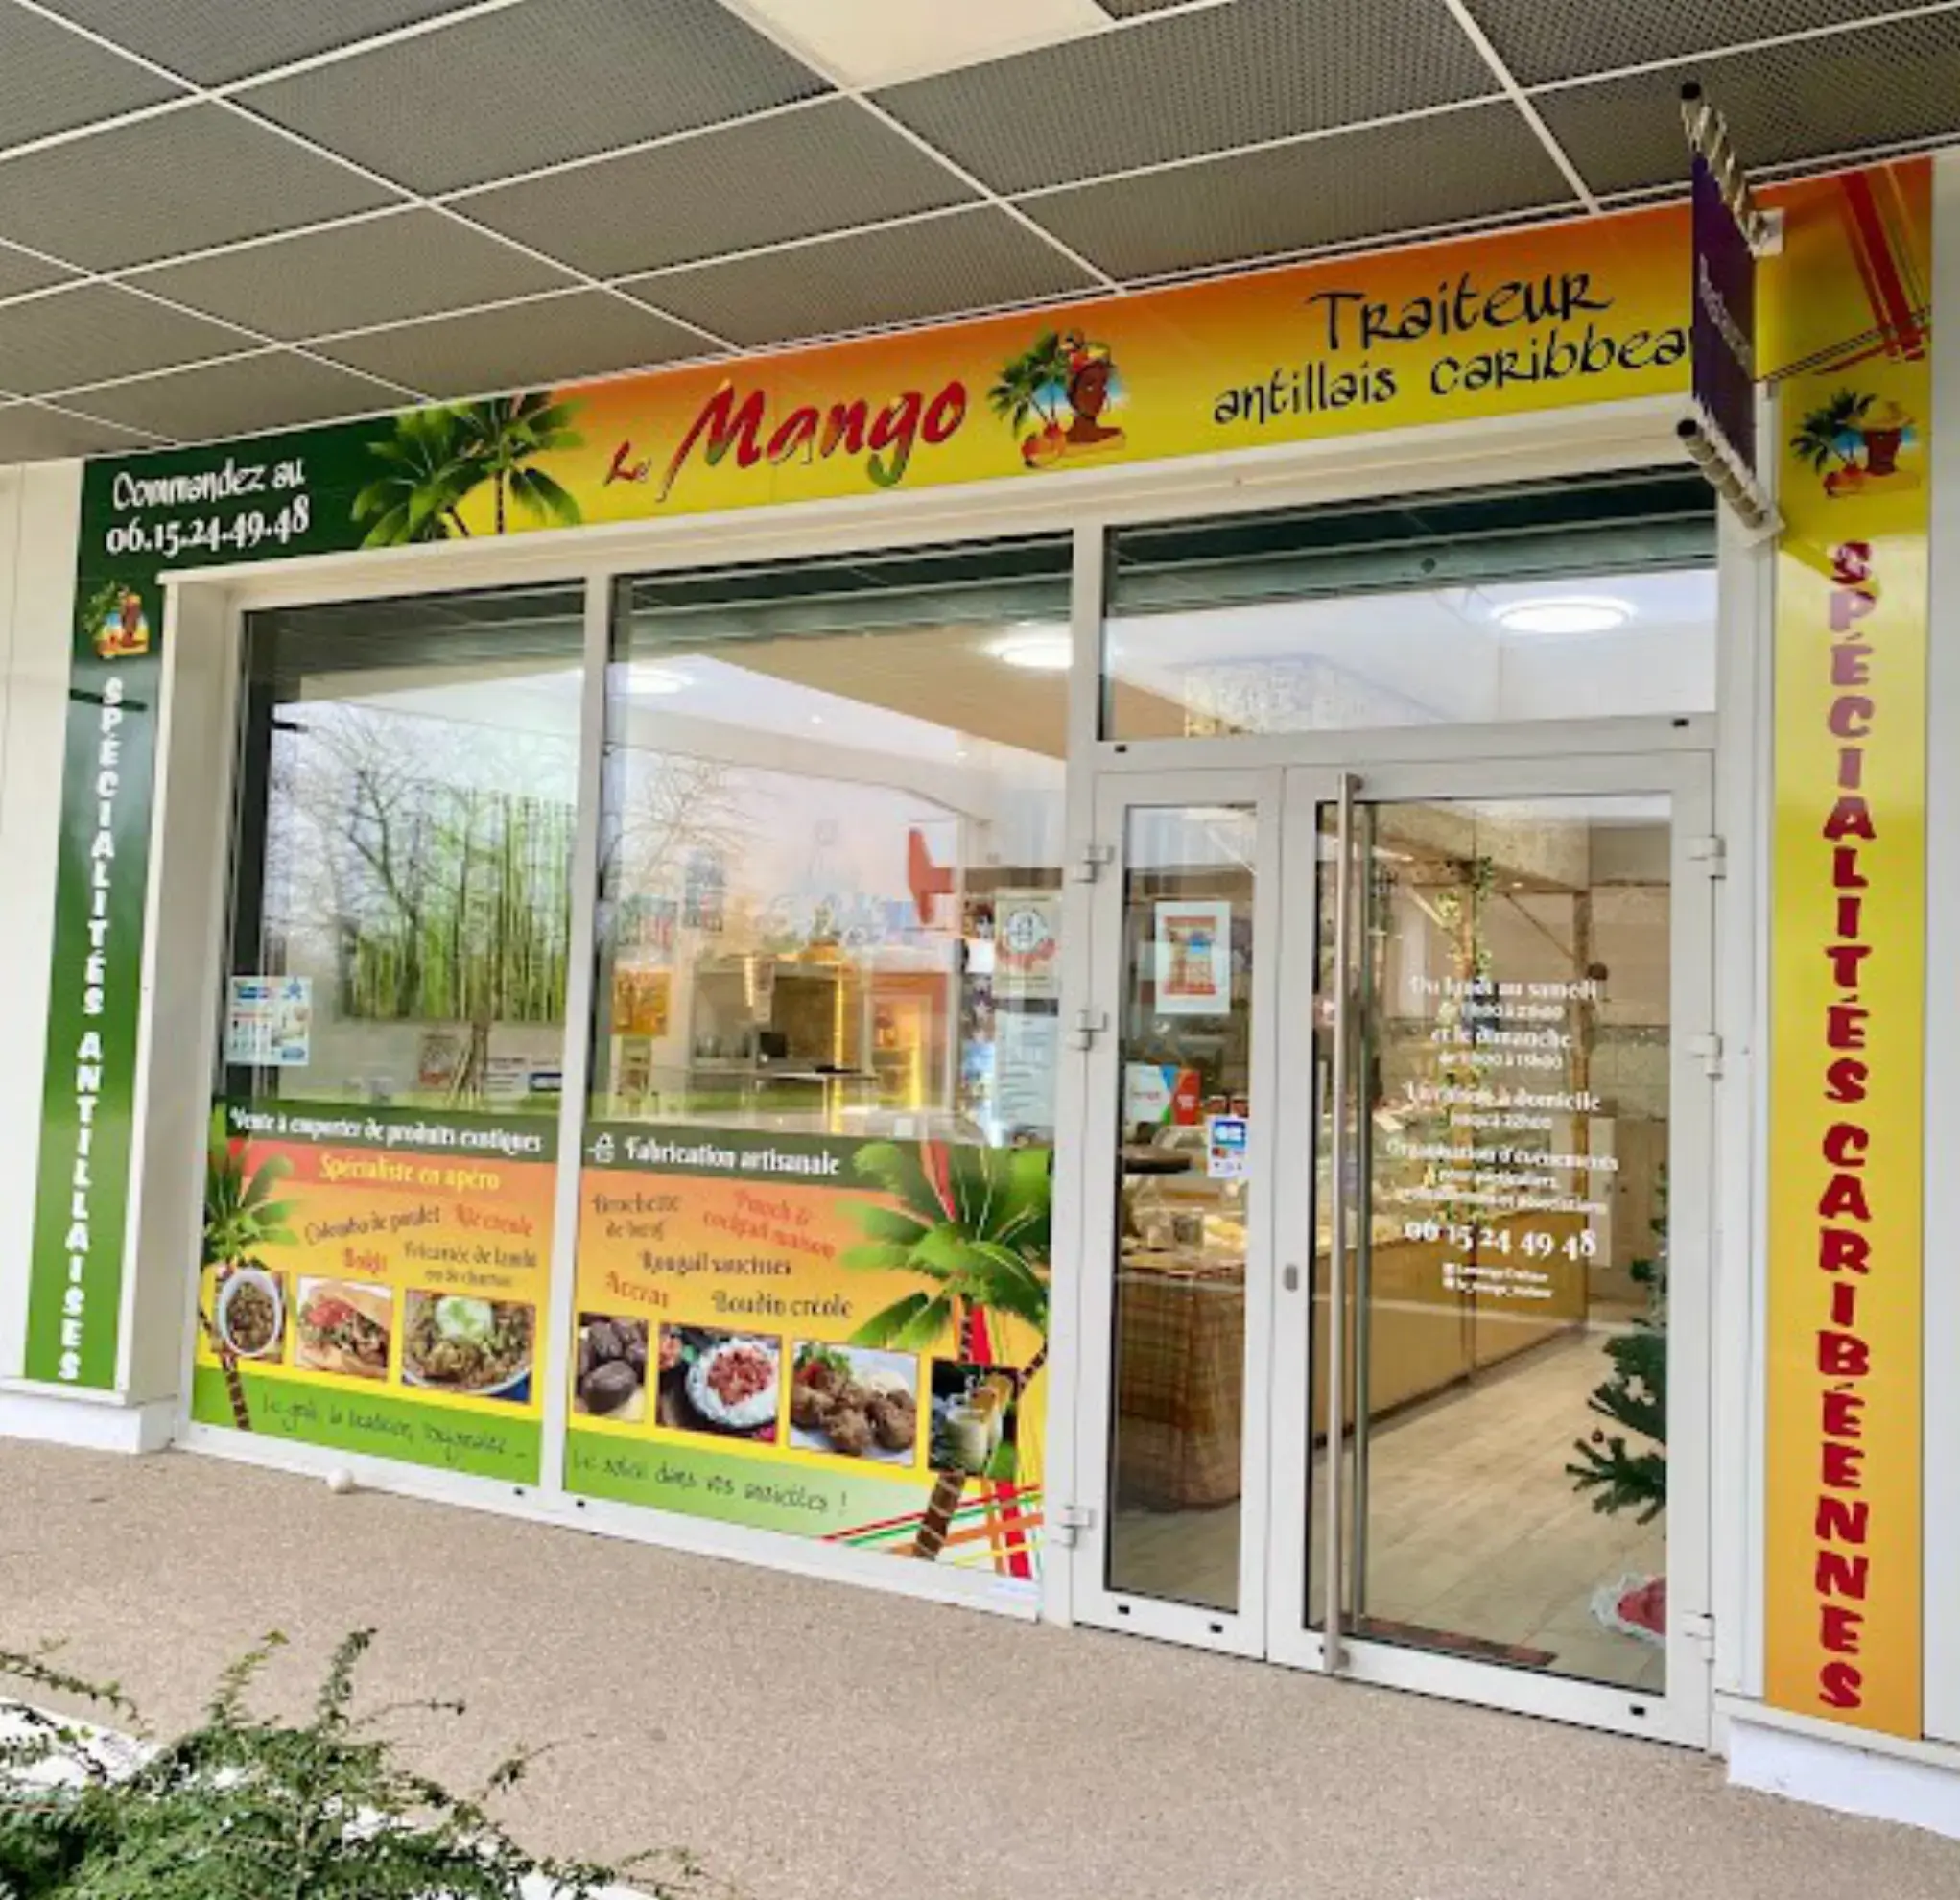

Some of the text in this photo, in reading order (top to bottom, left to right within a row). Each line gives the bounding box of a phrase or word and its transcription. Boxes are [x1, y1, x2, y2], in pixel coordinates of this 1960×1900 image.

[1305, 273, 1614, 350] Traiteur
[1214, 323, 1693, 424] antillais caribbea
[603, 378, 968, 503] Le Mango
[112, 456, 306, 511] Commandez au
[106, 494, 310, 558] 06.15.24.49.48
[1527, 979, 1597, 1000] samedi
[1476, 1024, 1574, 1049] dimanche
[1515, 1087, 1602, 1112] domicile
[229, 1106, 274, 1131] Vente
[364, 1117, 386, 1142] de
[386, 1121, 456, 1149] produits
[460, 1128, 543, 1156] exotiques
[624, 1135, 841, 1176] Fabrication artisanale
[58, 1030, 104, 1380] ANTILLAISES
[591, 1192, 682, 1216] Brochette
[605, 1219, 625, 1240] de
[1405, 1220, 1598, 1262] 06 15 24 49 48
[710, 1288, 788, 1318] Boudin
[1815, 1122, 1871, 1710] CARIBÉENNES
